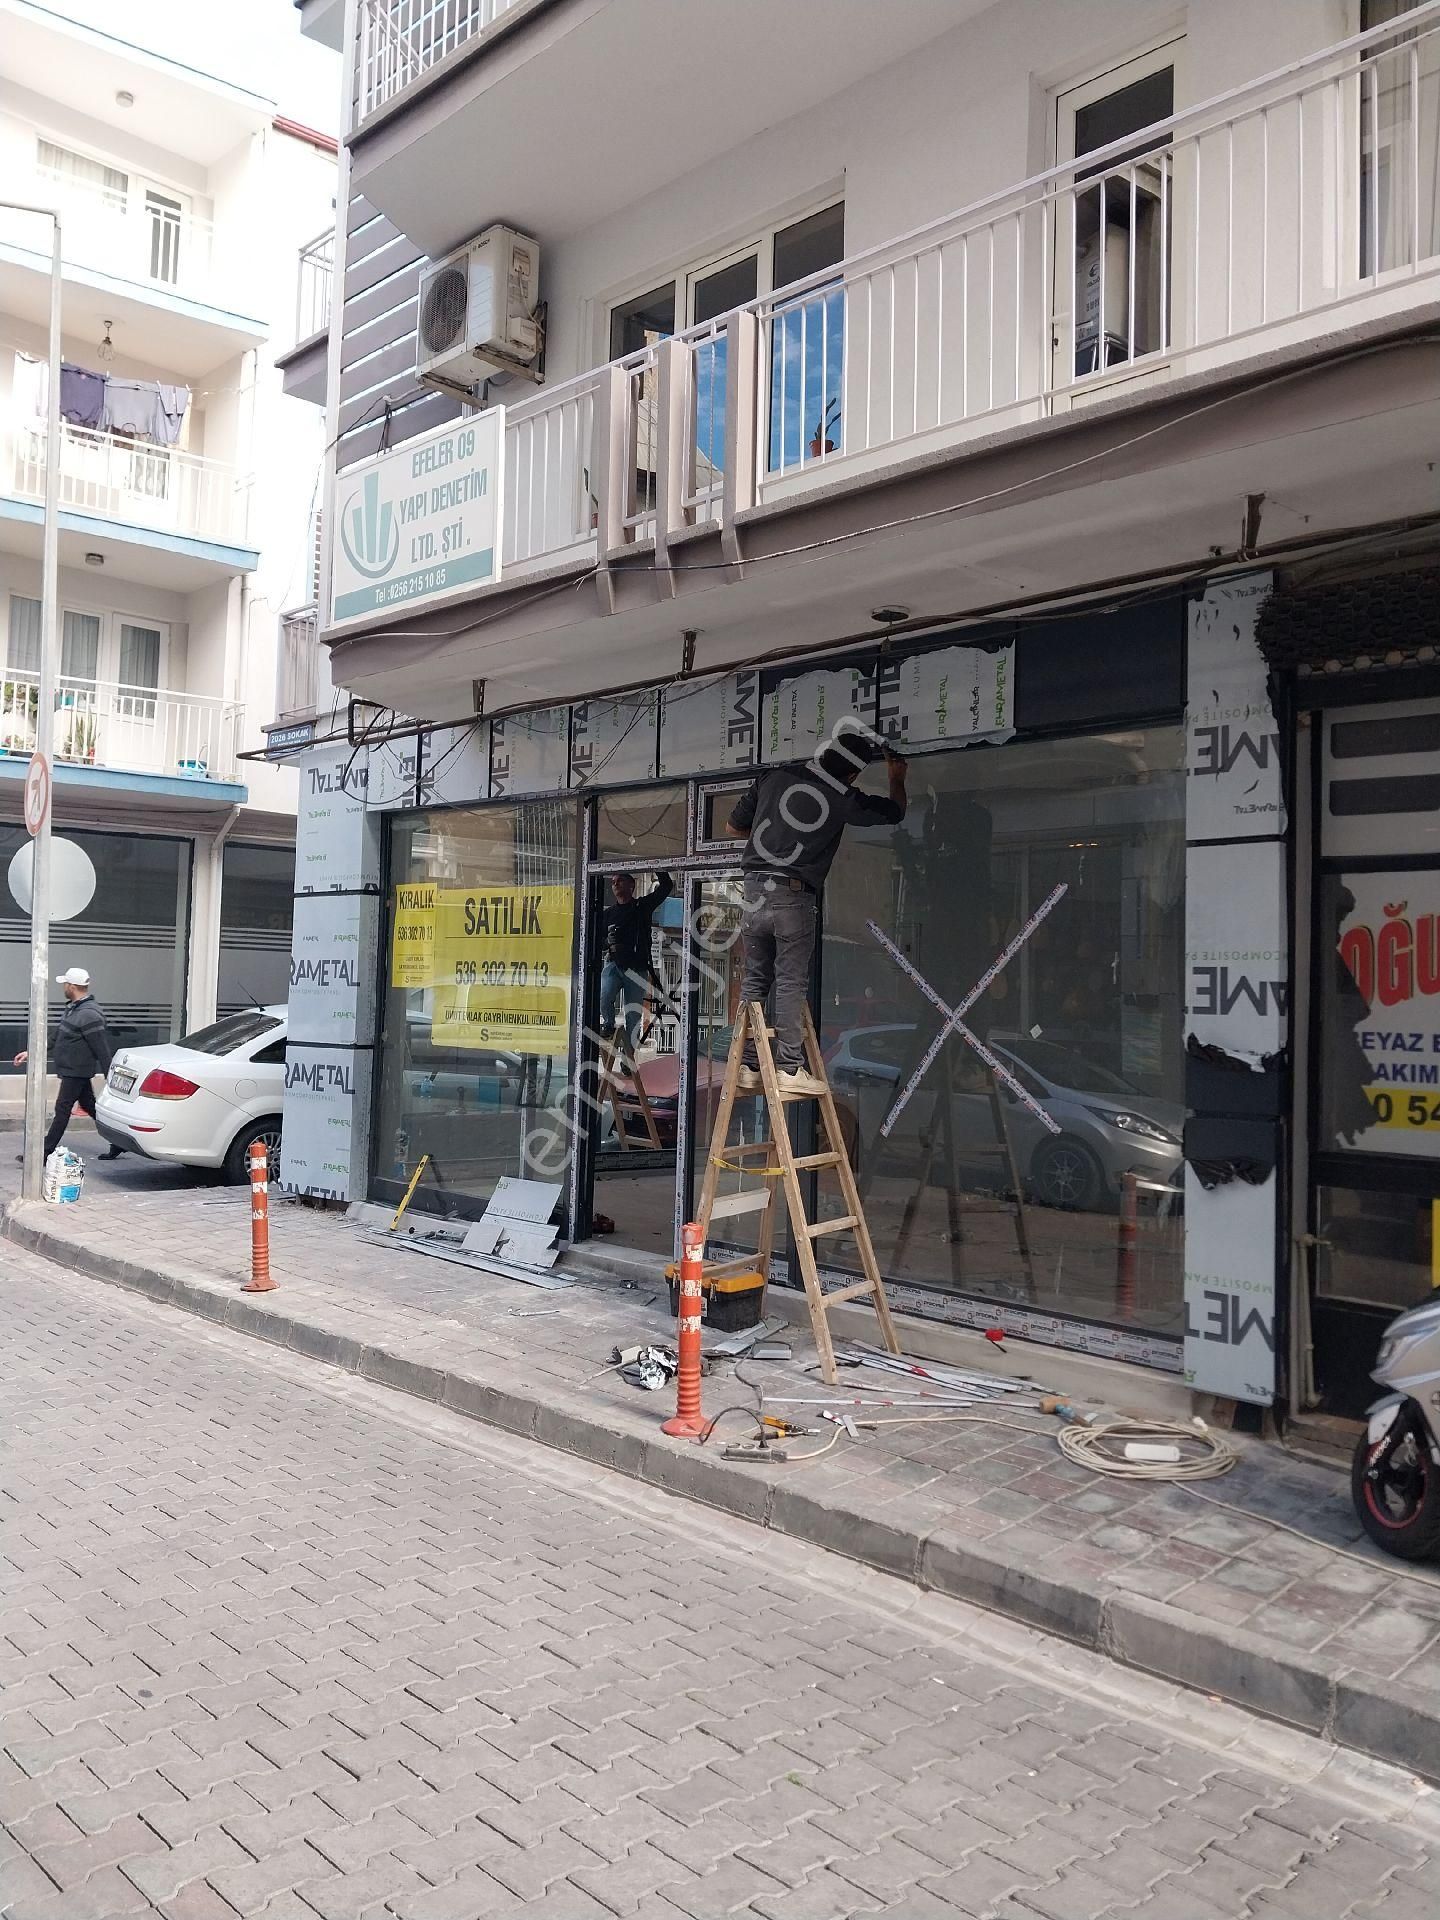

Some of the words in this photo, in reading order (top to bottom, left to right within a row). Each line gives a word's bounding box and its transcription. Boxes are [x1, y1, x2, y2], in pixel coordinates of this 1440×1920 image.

[412, 436, 454, 478] EFELER
[457, 429, 475, 461] 09
[400, 492, 427, 525] YAPI
[431, 468, 488, 514] DENETİM
[411, 533, 437, 563] LTD.
[409, 575, 423, 592] 215
[425, 573, 434, 588] 10
[436, 569, 446, 585] 85
[287, 728, 309, 740] SOKAK
[464, 896, 542, 935] SATILIK
[418, 926, 426, 940] 70
[455, 961, 476, 986] 536
[481, 961, 505, 987] 302
[510, 962, 528, 987] 70
[533, 962, 549, 988] 13
